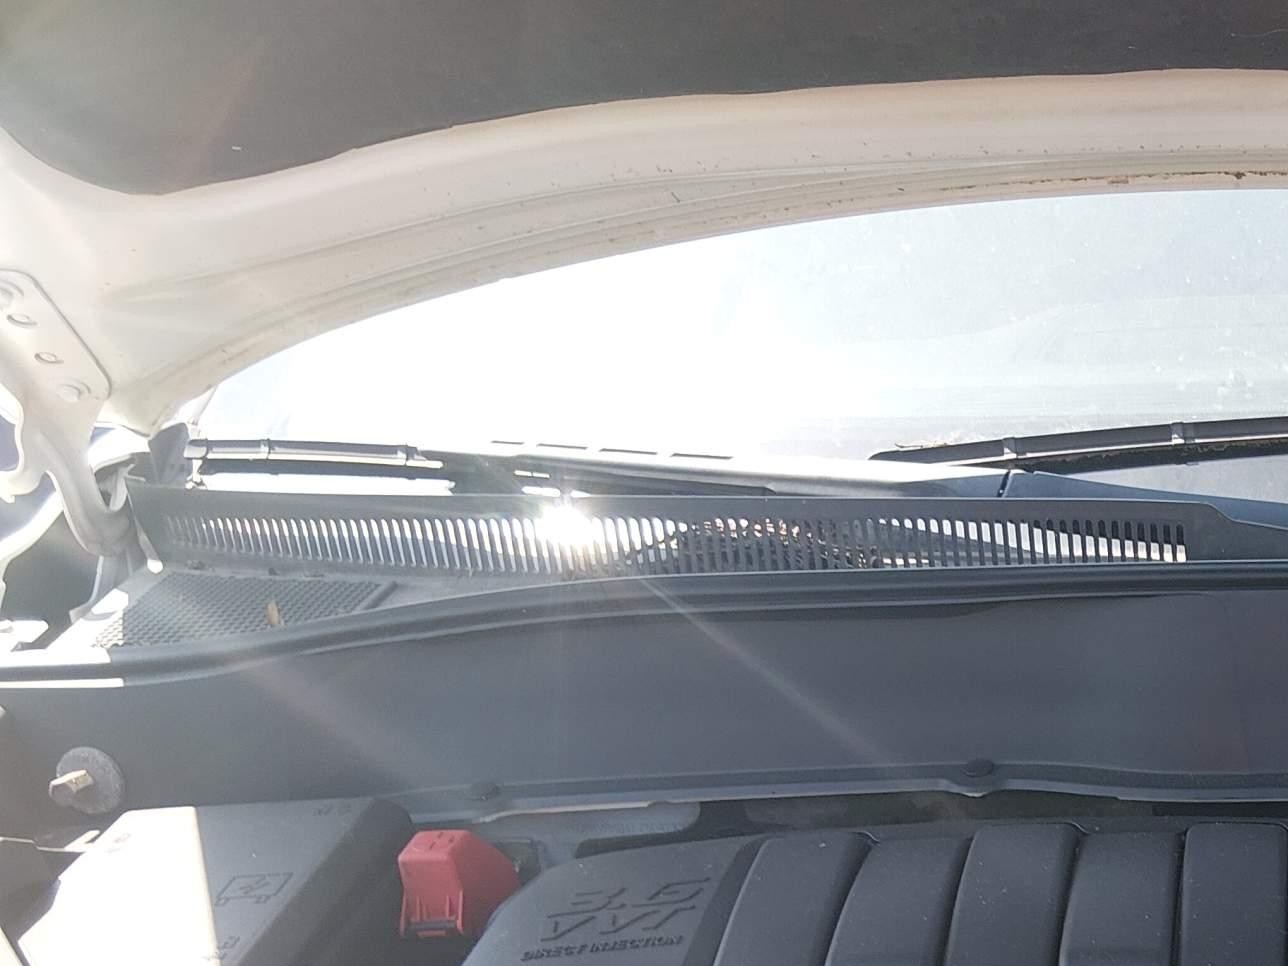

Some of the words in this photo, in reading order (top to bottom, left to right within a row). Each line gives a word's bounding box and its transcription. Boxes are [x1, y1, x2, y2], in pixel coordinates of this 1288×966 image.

[540, 905, 696, 942] VVT
[520, 944, 588, 962] DIRECT
[589, 936, 683, 954] INJECTION
